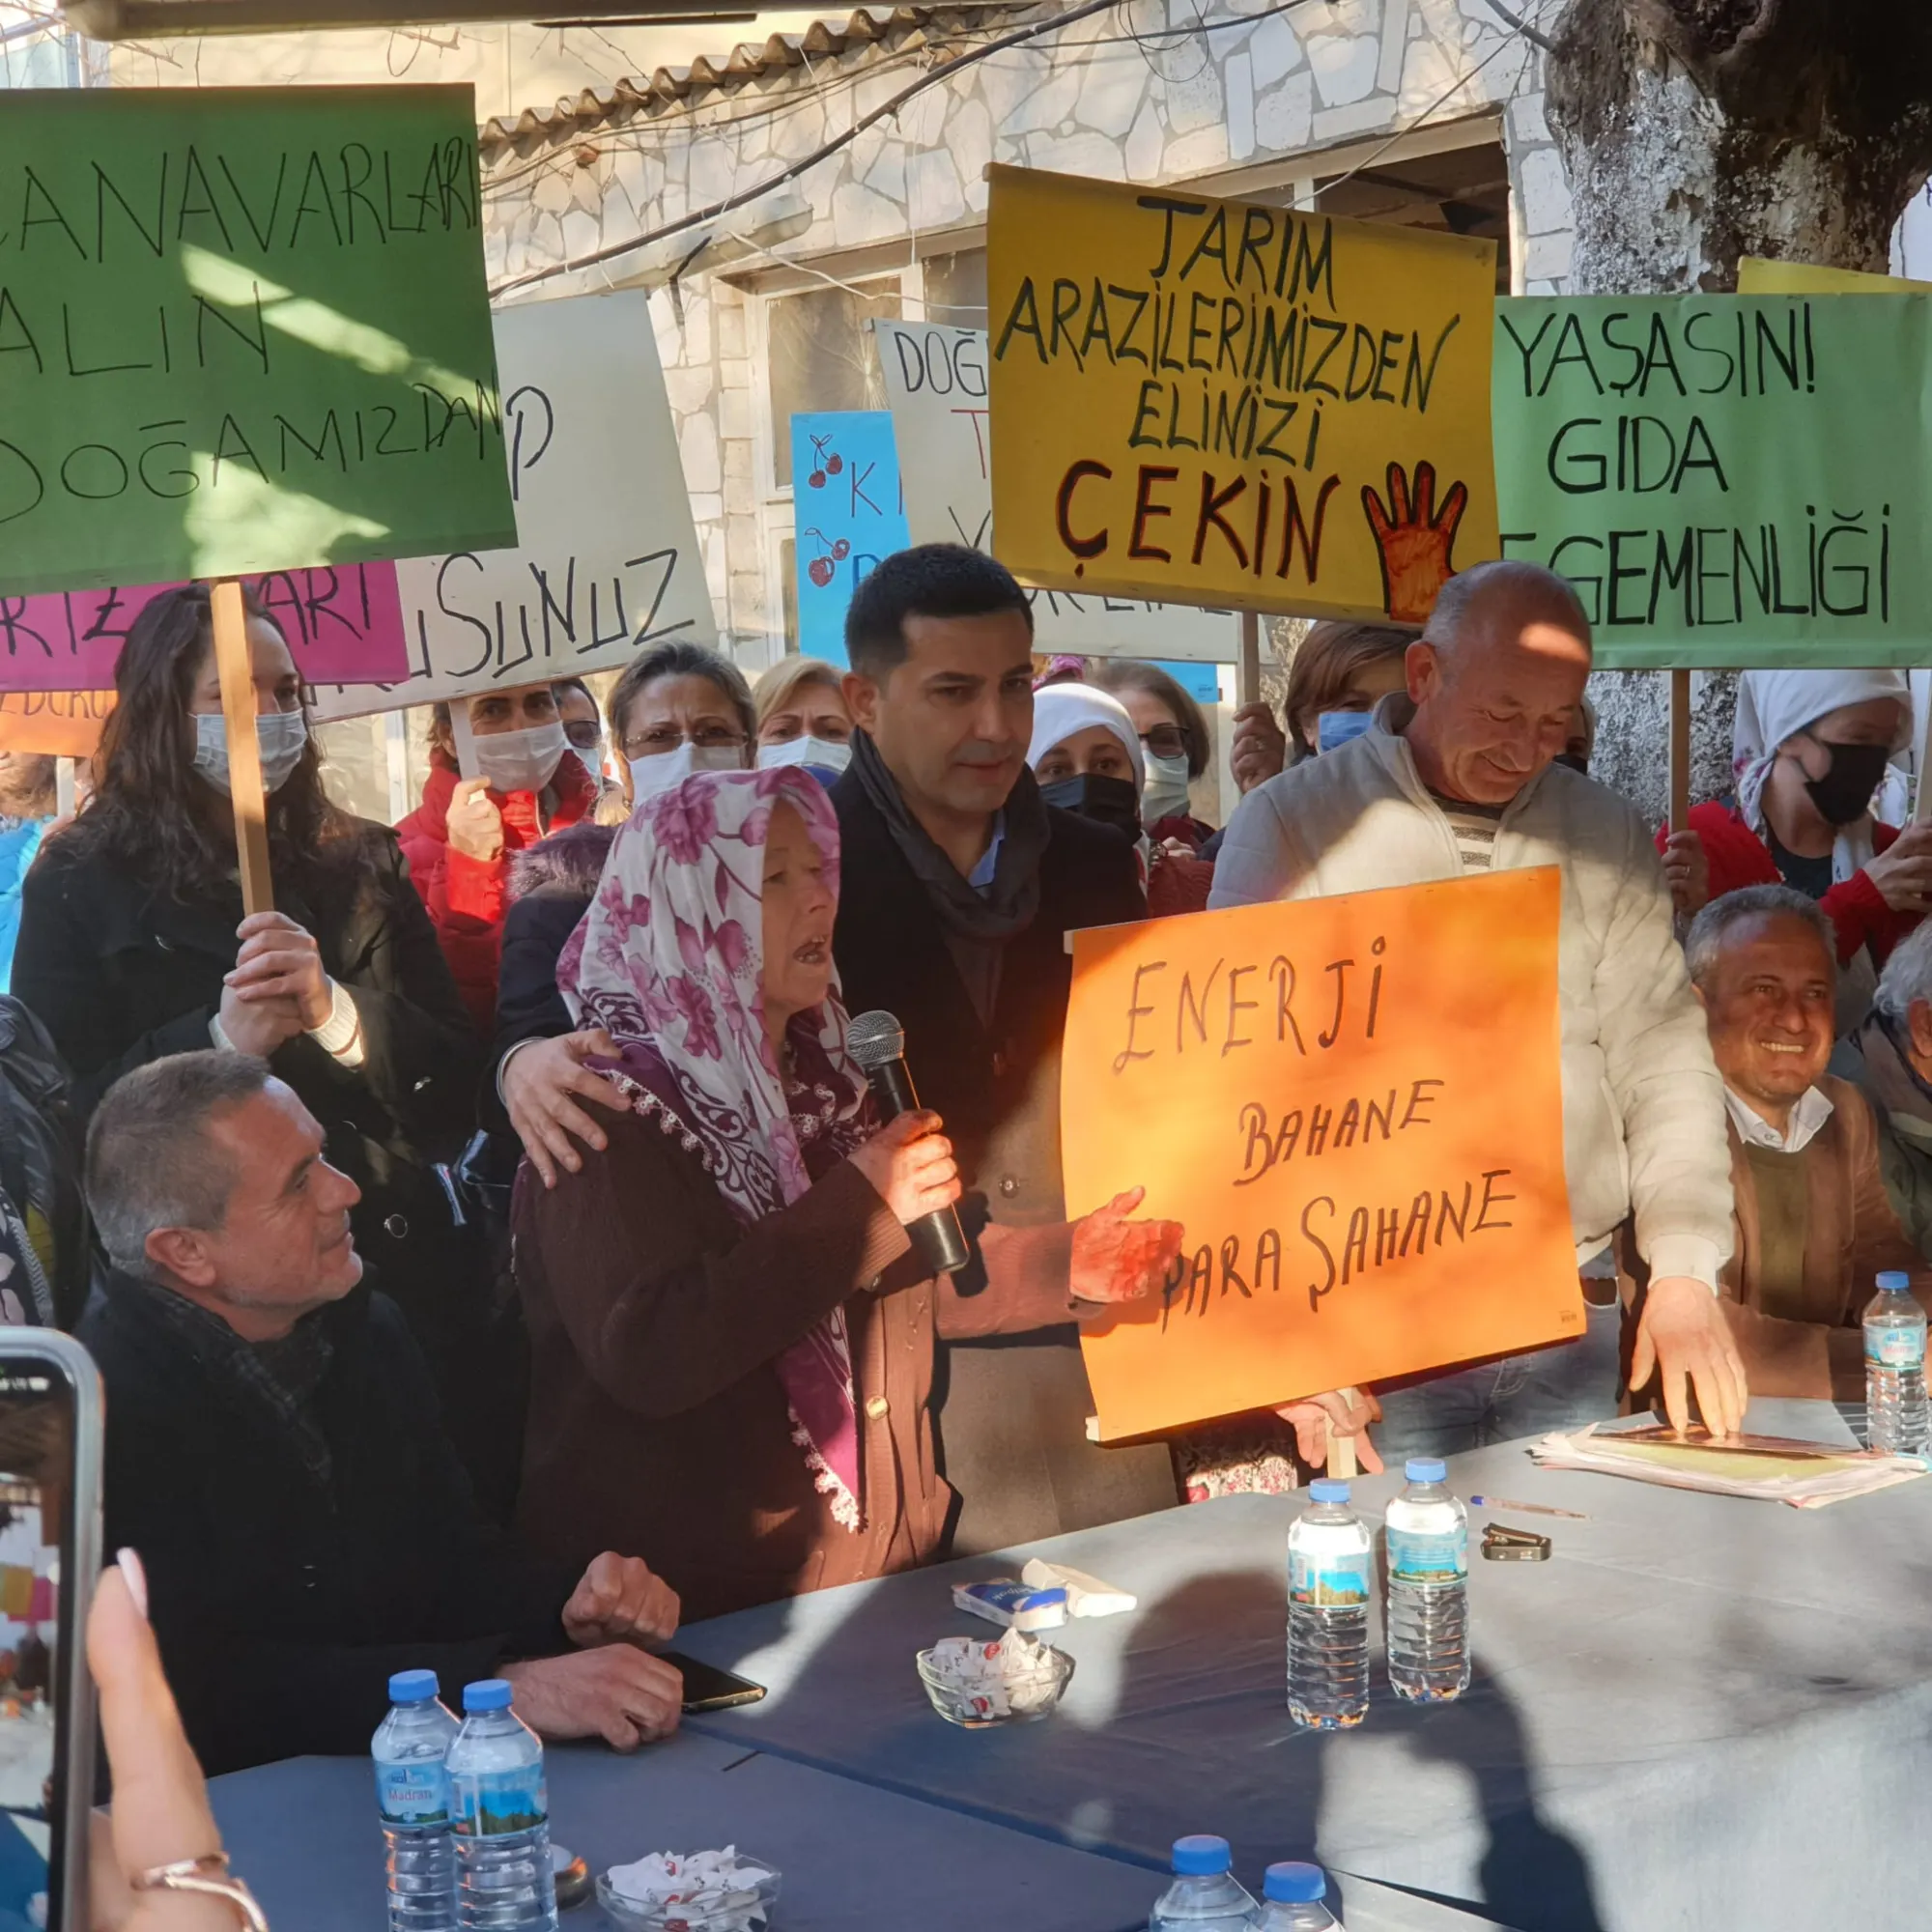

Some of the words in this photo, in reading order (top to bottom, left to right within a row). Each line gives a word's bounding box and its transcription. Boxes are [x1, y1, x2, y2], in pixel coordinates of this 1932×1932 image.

[0, 136, 478, 263] ANAVARLARI
[1136, 195, 1337, 313] TARIM
[894, 329, 989, 397] DOĞ
[993, 275, 1461, 413] ARAZİLERİMİZDEN
[1499, 302, 1816, 399] YAŞASIN!
[1127, 378, 1324, 472] ELİNİZİ
[1548, 415, 1729, 495] GIDA
[1055, 458, 1342, 585] ÇEKİN
[1112, 935, 1387, 1076] ENERJİ
[1232, 1078, 1446, 1187] BAHANE
[1160, 1227, 1283, 1335] PARA
